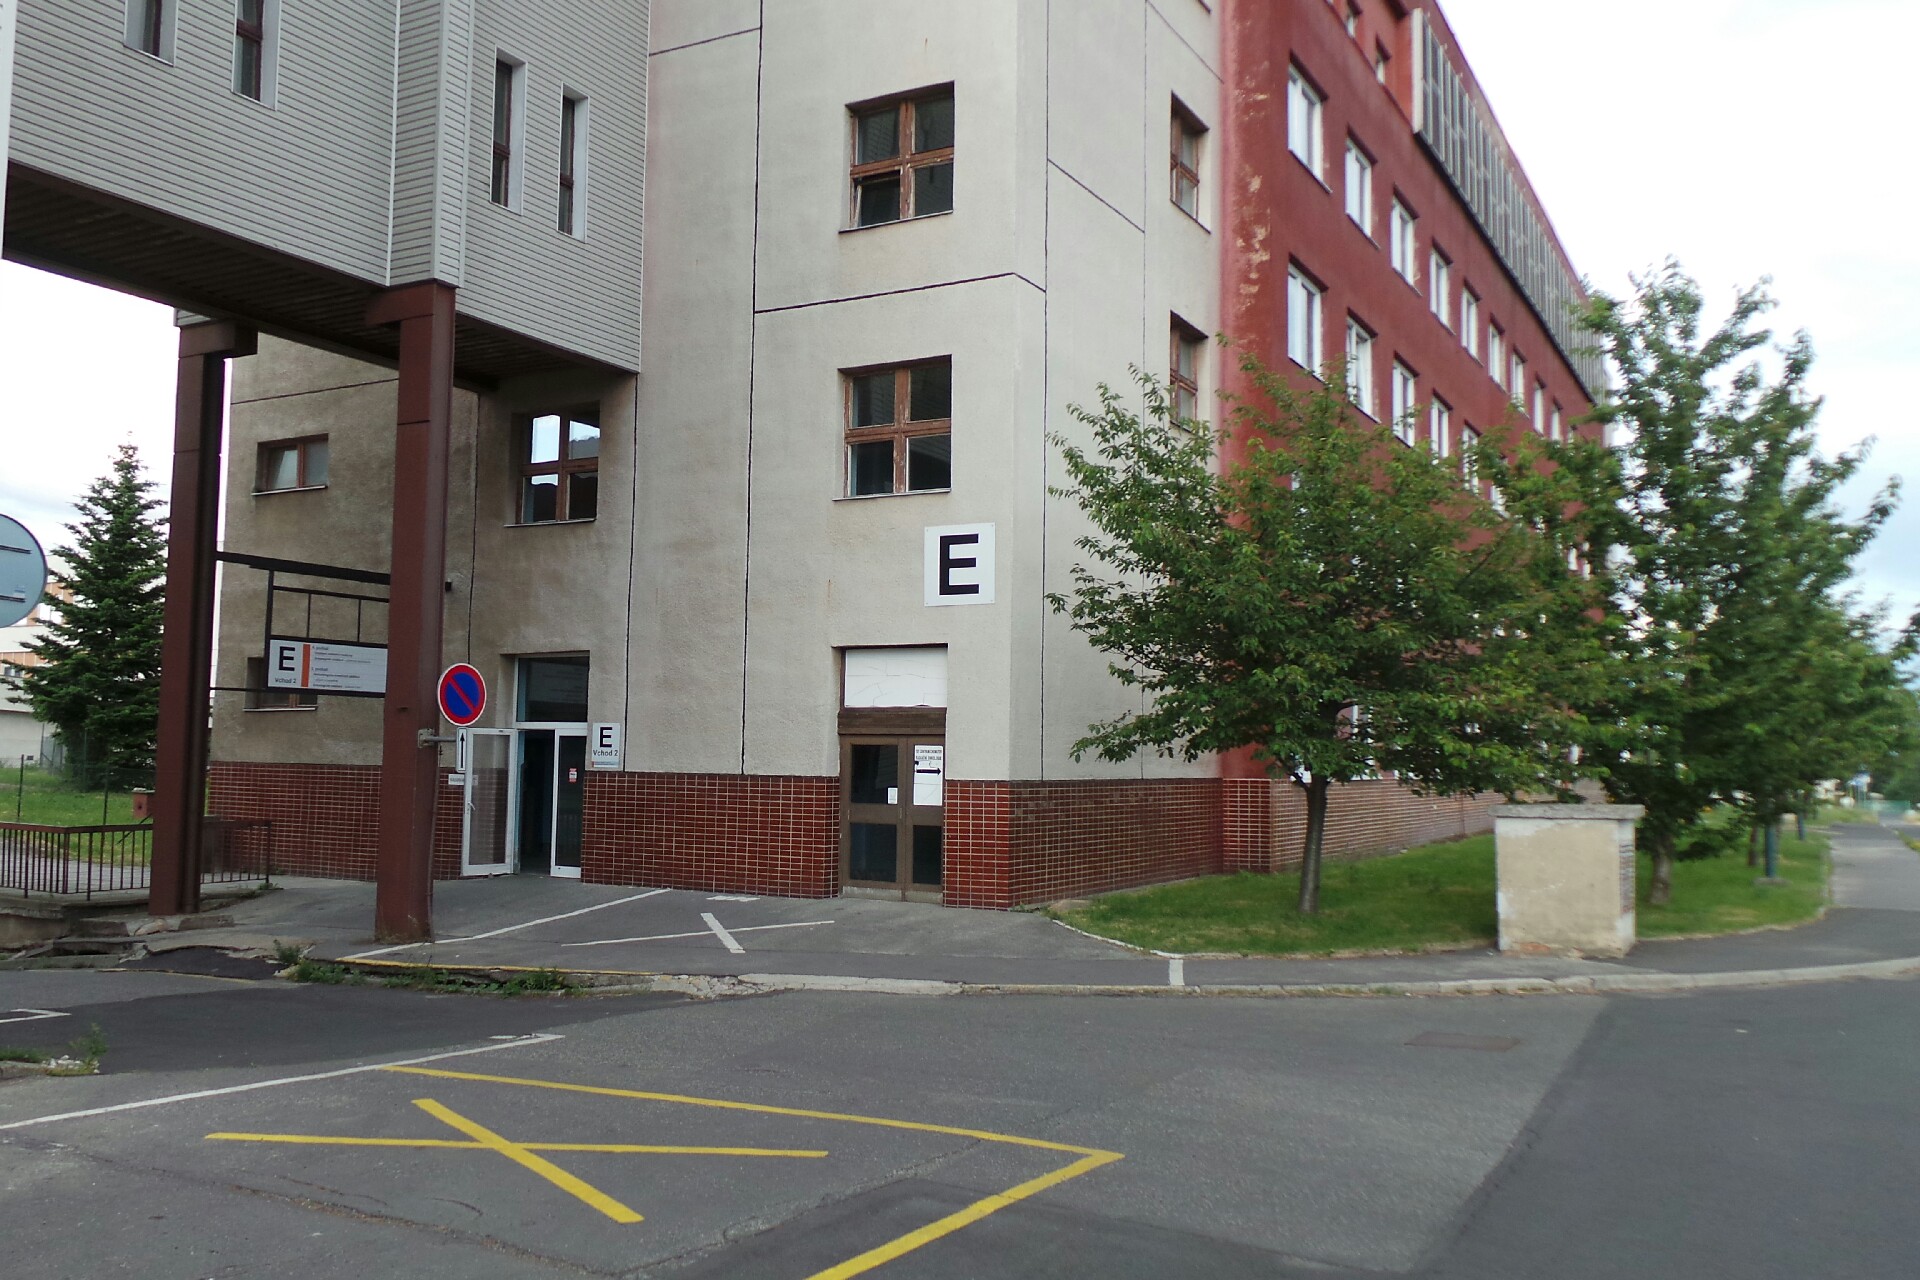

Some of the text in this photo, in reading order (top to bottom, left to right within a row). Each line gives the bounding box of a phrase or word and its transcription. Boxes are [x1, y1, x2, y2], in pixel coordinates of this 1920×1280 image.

[939, 533, 979, 595] E
[279, 646, 295, 671] E
[600, 727, 613, 747] E
